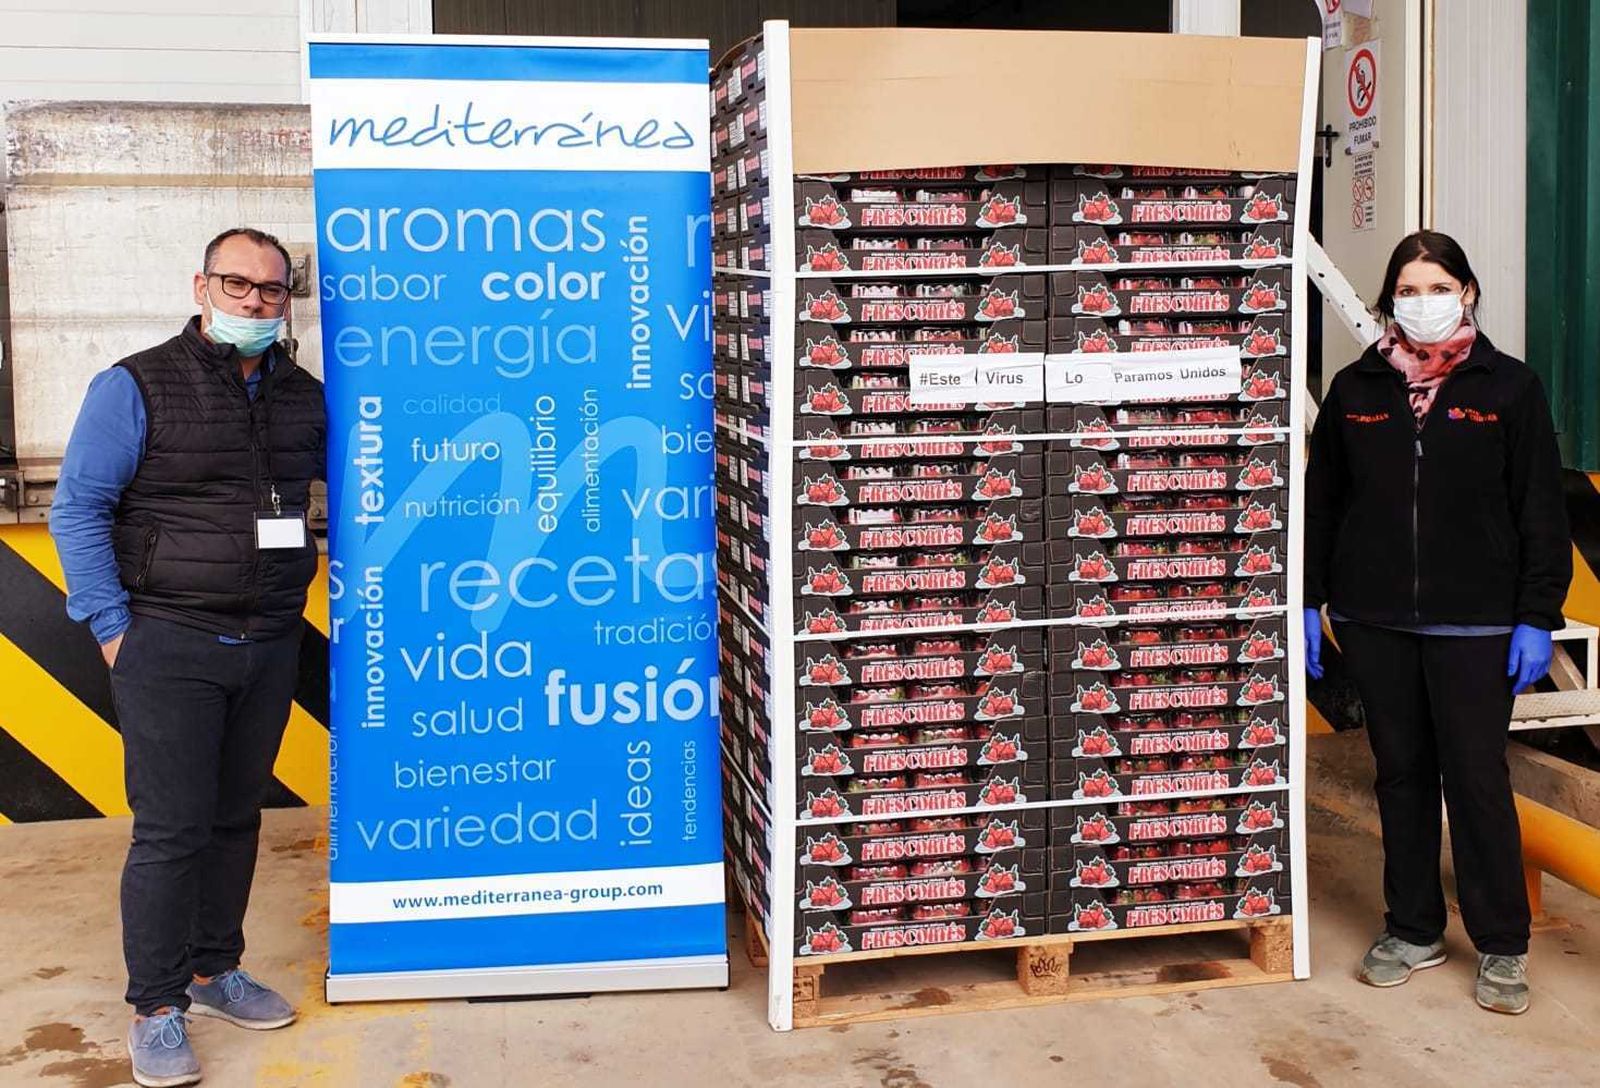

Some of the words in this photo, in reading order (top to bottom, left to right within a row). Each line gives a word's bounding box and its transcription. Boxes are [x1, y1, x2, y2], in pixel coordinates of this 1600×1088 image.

[329, 101, 694, 149] mediterránea
[325, 206, 606, 252] aromas
[322, 265, 447, 301] sabor
[481, 262, 605, 300] color
[620, 215, 651, 389] innovación
[335, 309, 598, 379] energía
[919, 372, 962, 386] #Este
[986, 370, 1024, 385] Virus
[1065, 372, 1083, 384] Lo
[1114, 370, 1174, 383] Paramos
[1180, 366, 1227, 380] Unidos
[403, 394, 501, 415] calidad
[354, 395, 384, 525] textura
[410, 437, 501, 463] futuro
[530, 395, 558, 533] equilibrio
[578, 389, 599, 533] alimentación
[404, 493, 520, 518] nutrición
[361, 566, 385, 729] innovación
[400, 631, 533, 682] vida
[412, 697, 524, 738] salud
[394, 754, 557, 789] bienestar
[620, 740, 652, 847] ideas
[682, 740, 696, 842] tendencias
[356, 799, 598, 851] variedad
[393, 881, 664, 909] www.mediterranea-group.com
